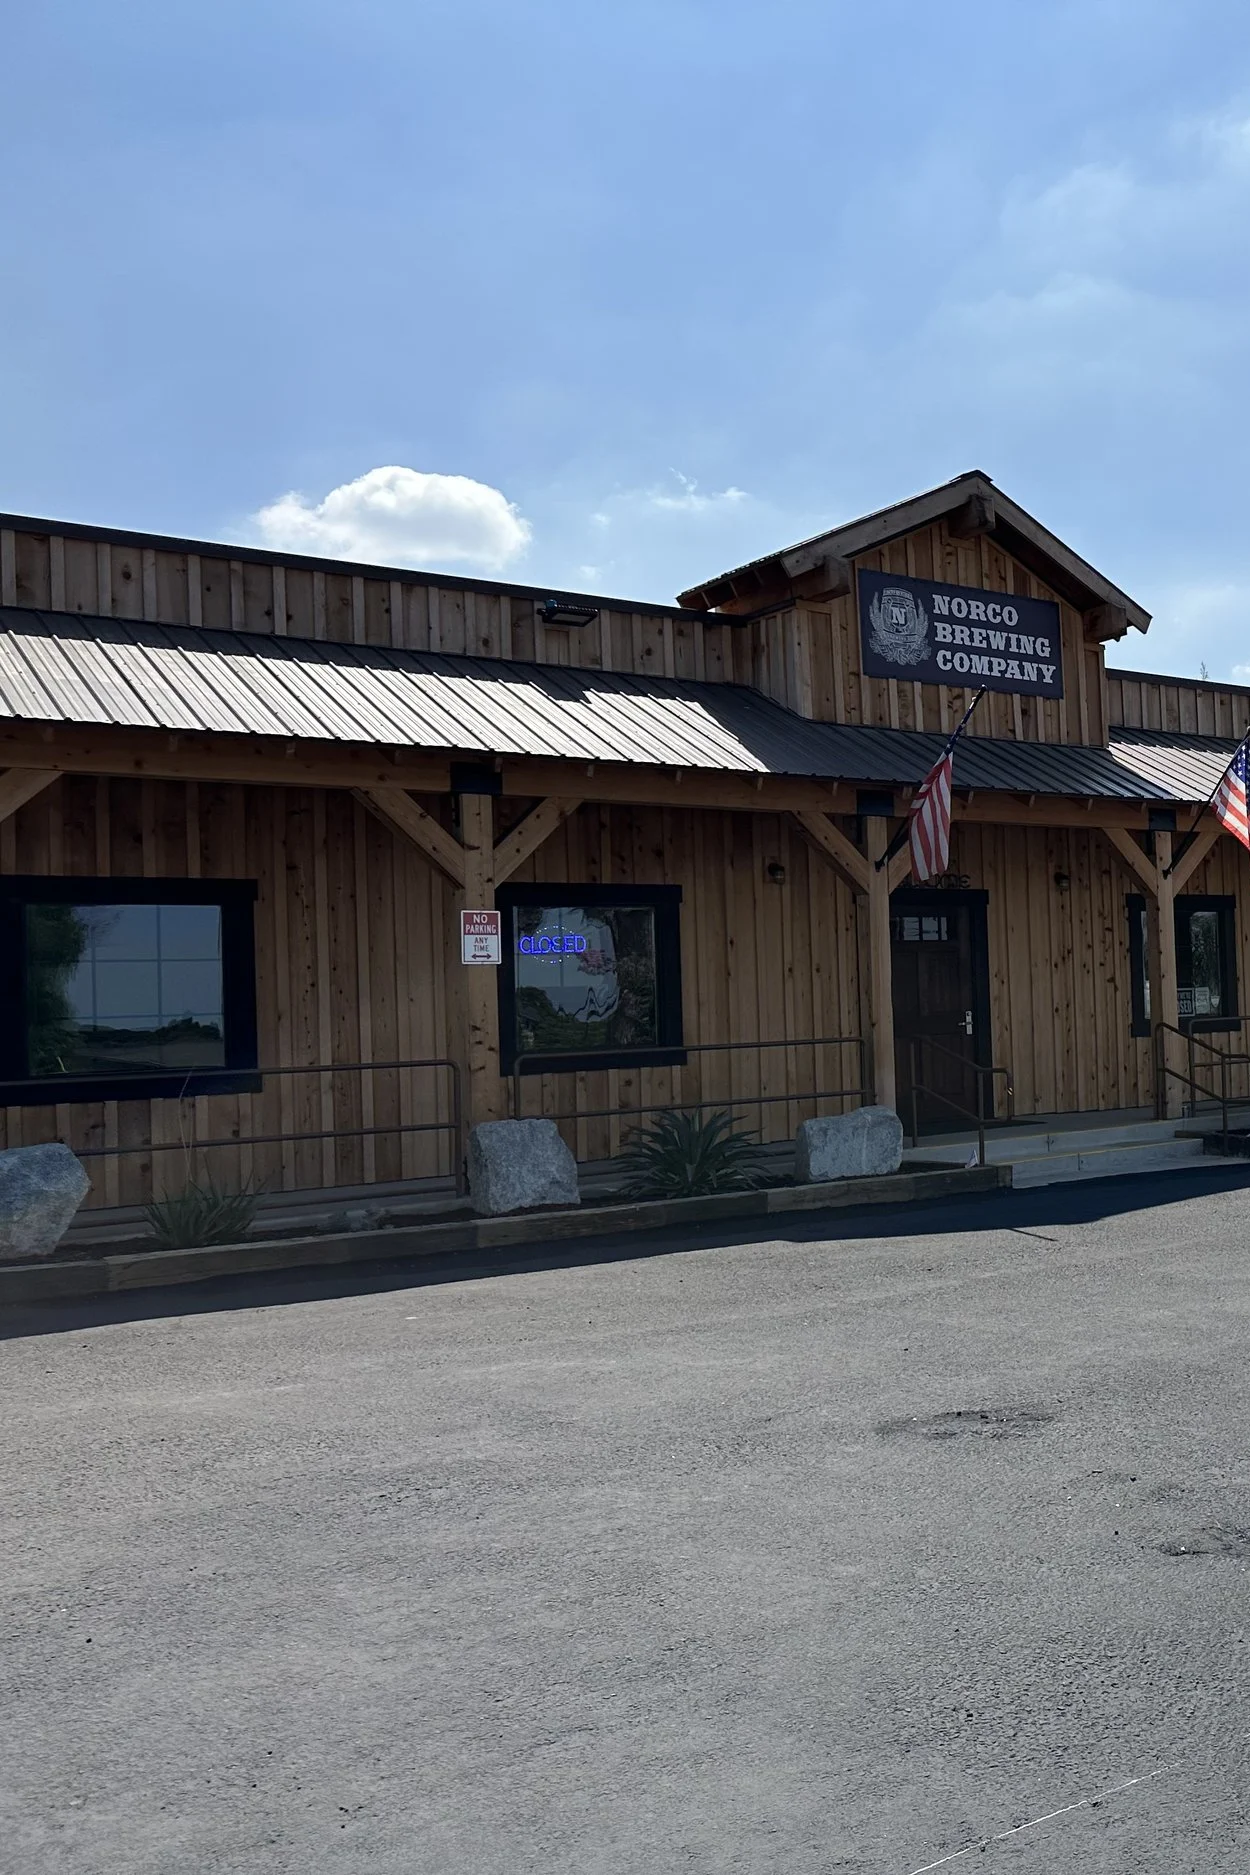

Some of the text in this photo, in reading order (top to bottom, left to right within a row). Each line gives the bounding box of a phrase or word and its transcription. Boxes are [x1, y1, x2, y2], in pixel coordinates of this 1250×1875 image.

[892, 606, 906, 624] N
[932, 594, 1018, 627] NORCO
[934, 622, 1050, 657] BREWING
[936, 650, 1056, 683] COMPANY
[473, 914, 488, 924] NO
[465, 924, 497, 934] PARKING
[473, 944, 490, 952] TIME
[519, 935, 587, 954] CLOSED
